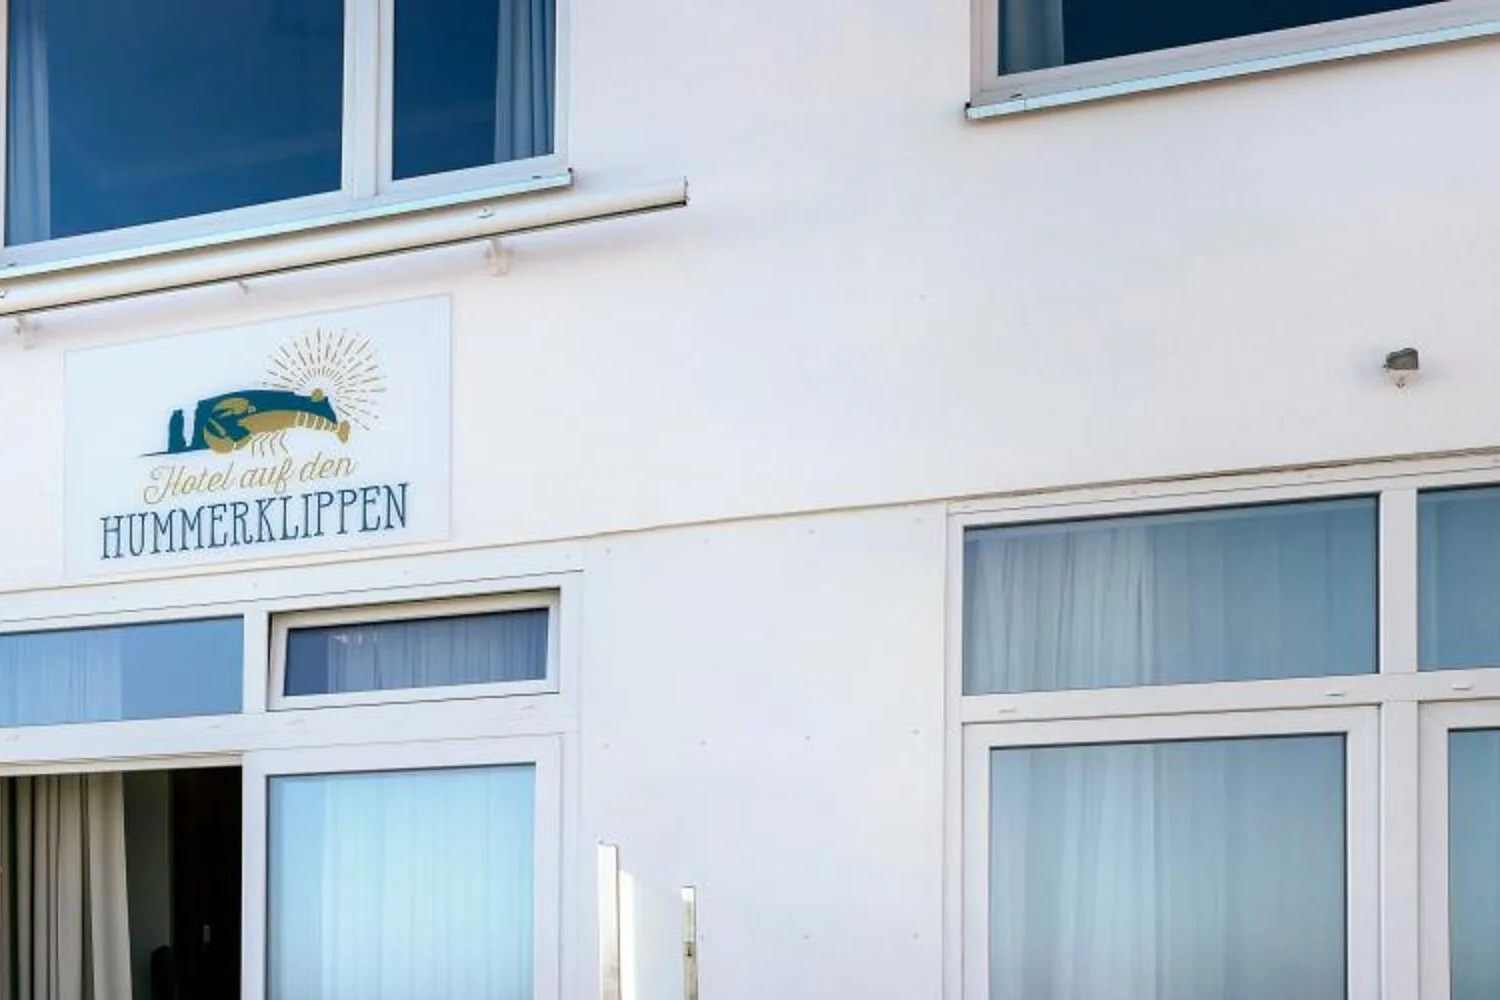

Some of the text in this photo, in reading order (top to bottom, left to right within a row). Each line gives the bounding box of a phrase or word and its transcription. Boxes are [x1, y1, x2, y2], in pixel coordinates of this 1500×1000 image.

[143, 450, 356, 504] Hotel auf den
[100, 482, 410, 560] HUMMERKLIPPEN
